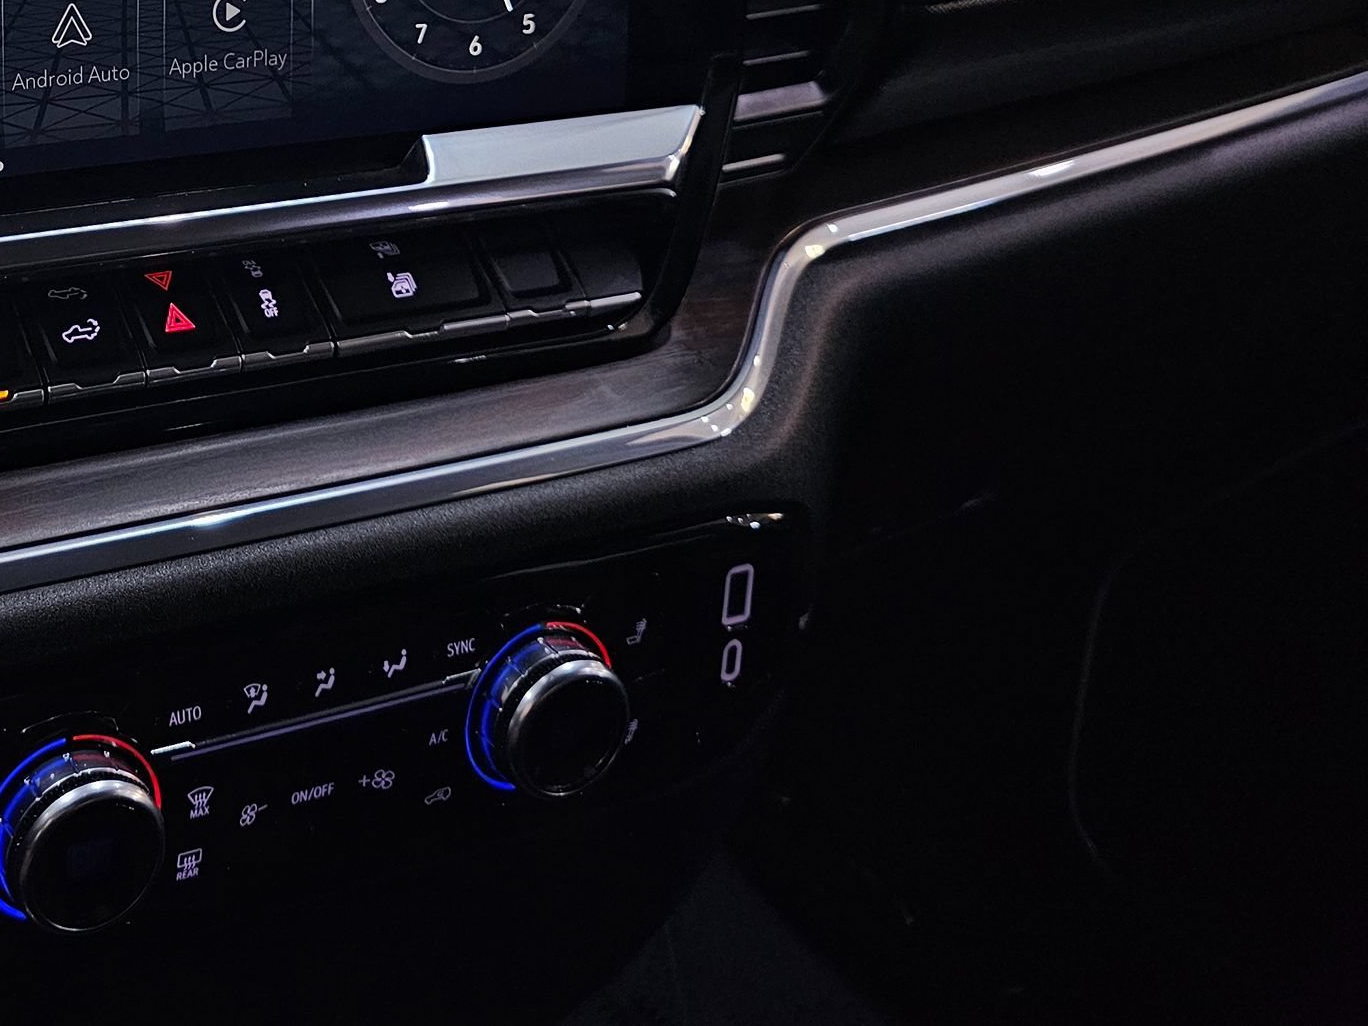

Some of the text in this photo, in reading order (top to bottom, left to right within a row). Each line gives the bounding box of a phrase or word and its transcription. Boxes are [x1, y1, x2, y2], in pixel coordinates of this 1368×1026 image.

[416, 24, 427, 43] 7
[523, 14, 535, 34] 5
[469, 36, 482, 55] 6
[169, 49, 287, 78] Apple CarPlay
[12, 66, 129, 90] Android Auto
[264, 306, 279, 318] OFF
[448, 638, 474, 657] SYNC
[170, 706, 201, 726] AUTO
[429, 729, 448, 745] A/C
[292, 783, 333, 804] ON/OFF
[190, 806, 209, 819] MAX
[176, 867, 199, 881] REAR
